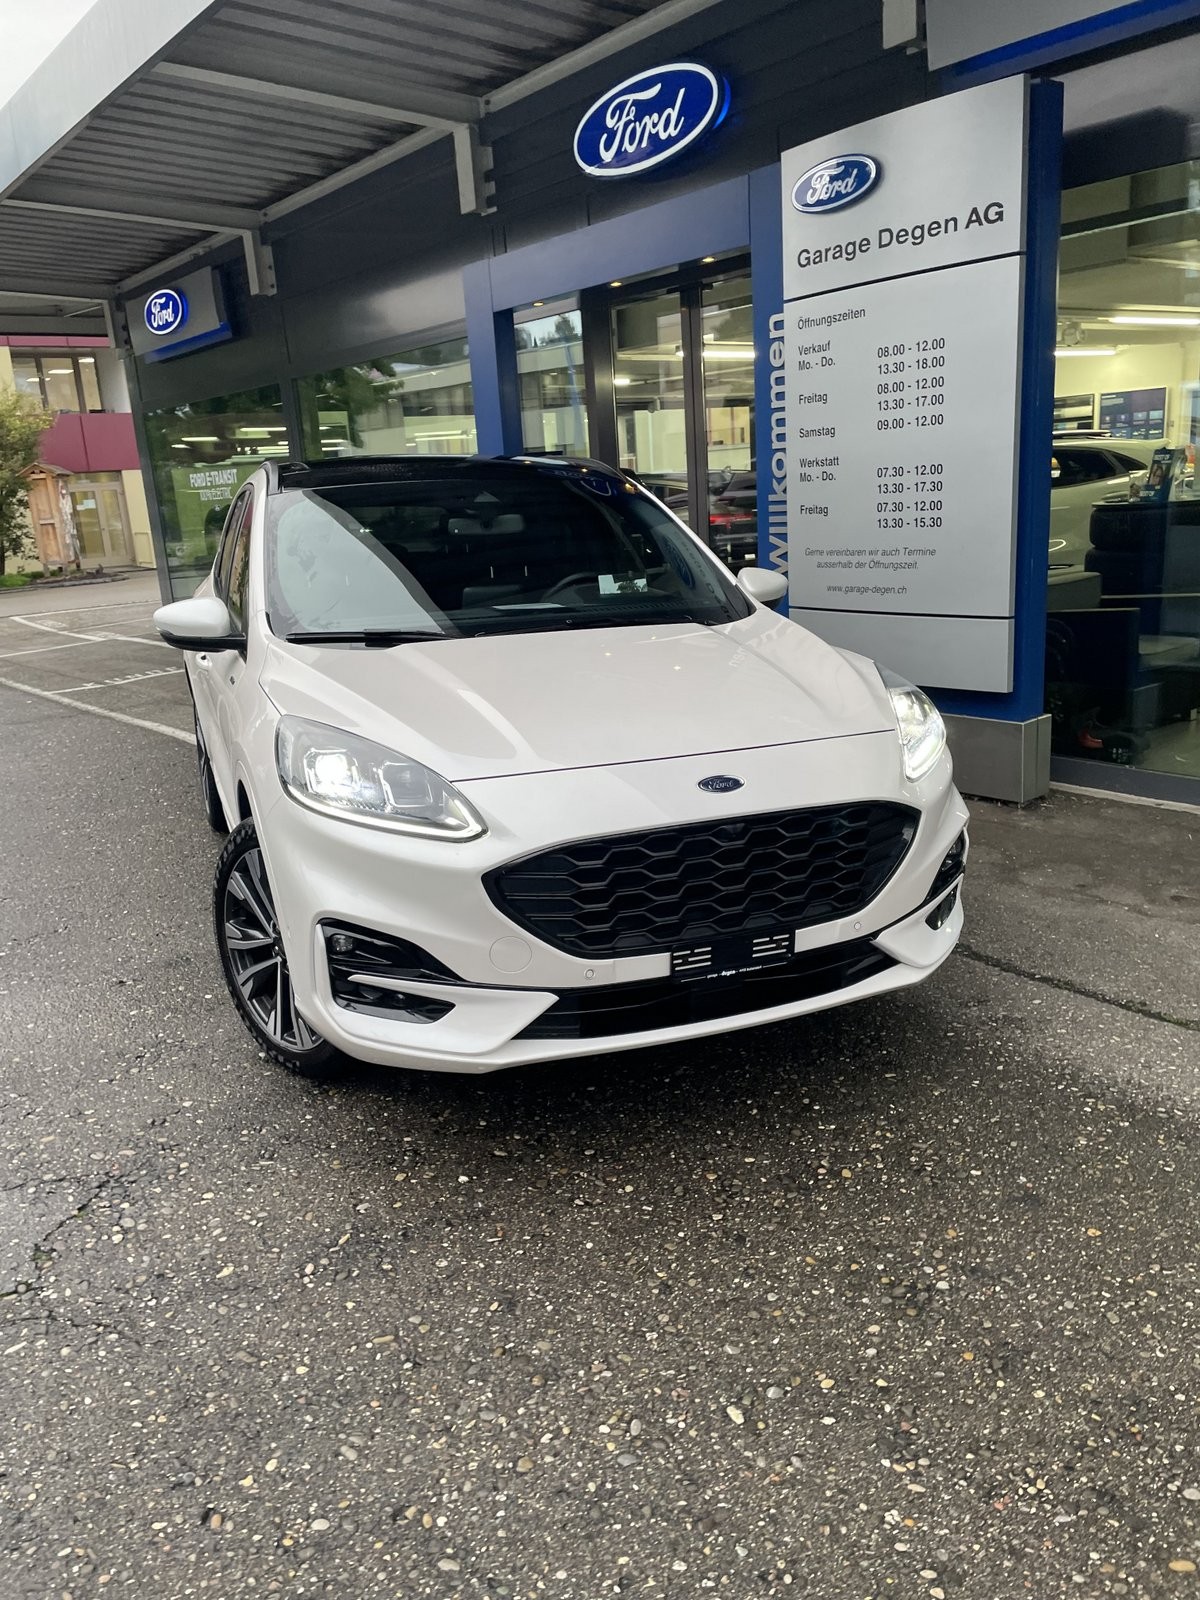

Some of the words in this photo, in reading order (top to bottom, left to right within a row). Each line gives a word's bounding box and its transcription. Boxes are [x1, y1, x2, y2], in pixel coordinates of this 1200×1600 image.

[599, 83, 686, 162] Ford
[807, 165, 858, 204] Ford
[797, 237, 871, 268] Garage
[877, 216, 958, 249] Degen
[965, 201, 1004, 230] AG
[151, 296, 175, 327] Ford
[797, 308, 866, 330] Öffnungszeiten
[798, 340, 831, 356] Verkauf
[798, 360, 814, 371] Mo.
[820, 356, 836, 368] Do.
[877, 344, 905, 358] 08.00
[915, 337, 945, 353] 12.00
[877, 361, 905, 375] 13.30
[915, 355, 945, 370] 18.00
[798, 392, 828, 405] Freitag
[877, 381, 905, 395] 08.00
[915, 376, 945, 391] 12.00
[877, 398, 904, 411] 13.30
[915, 393, 944, 408] 17.00
[799, 426, 836, 439] Samstag
[877, 418, 904, 431] 09.00
[914, 413, 944, 427] 12.00
[768, 312, 788, 574] Willkommen
[799, 456, 839, 468] Werkstatt
[800, 472, 814, 483] Mo.
[821, 471, 836, 482] Do.
[876, 466, 904, 478] 07.30
[914, 463, 943, 476] 12.00
[877, 483, 904, 494] 13.30
[914, 480, 943, 492] 17.30
[800, 504, 829, 516] Freitag
[876, 502, 904, 513] 07.30
[914, 500, 943, 512] 12.00
[877, 517, 904, 529] 13.30
[913, 516, 943, 528] 15.30
[868, 548, 879, 556] wir
[881, 547, 900, 557] auch
[902, 546, 937, 557] Termine
[854, 560, 867, 569] der
